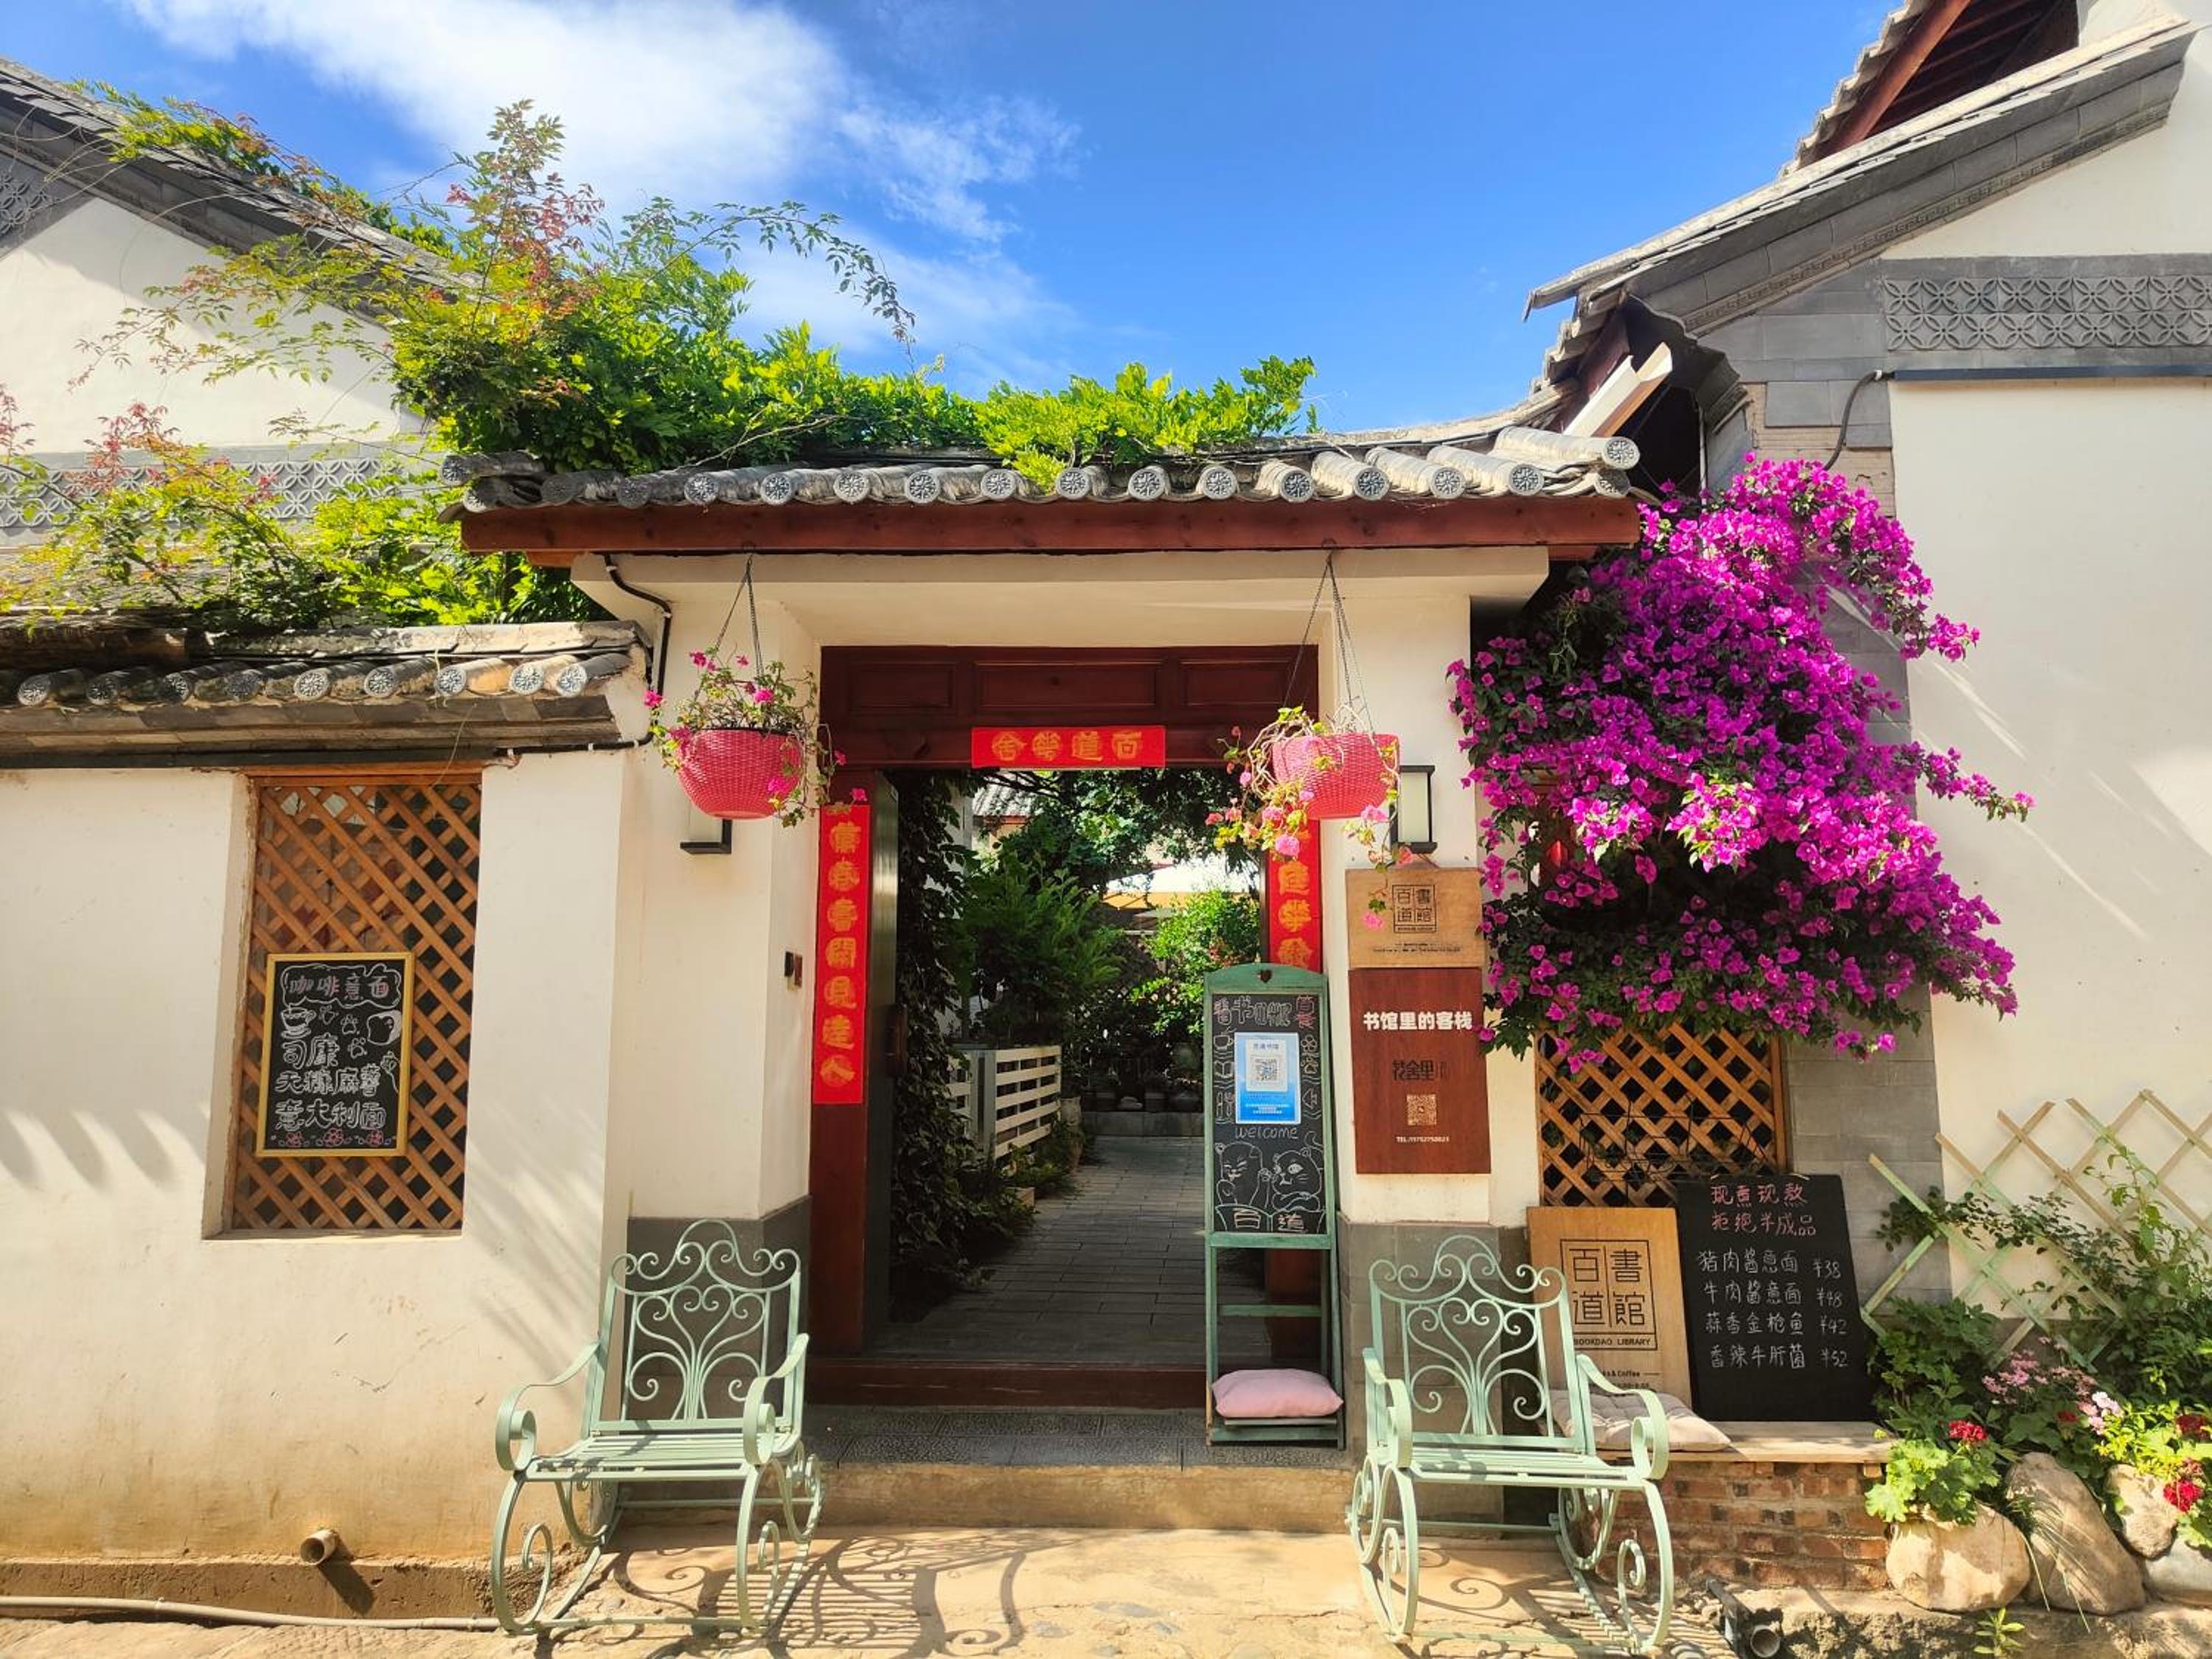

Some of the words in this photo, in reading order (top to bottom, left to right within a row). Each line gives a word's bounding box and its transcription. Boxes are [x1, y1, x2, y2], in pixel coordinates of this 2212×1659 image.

[1363, 1011, 1472, 1031] 书馆里的客栈
[1711, 1211, 1817, 1237] 拒绝半成品
[1704, 1311, 1804, 1335] 蒜香金枪鱼
[1711, 1343, 1805, 1369] 香辣牛肝菌
